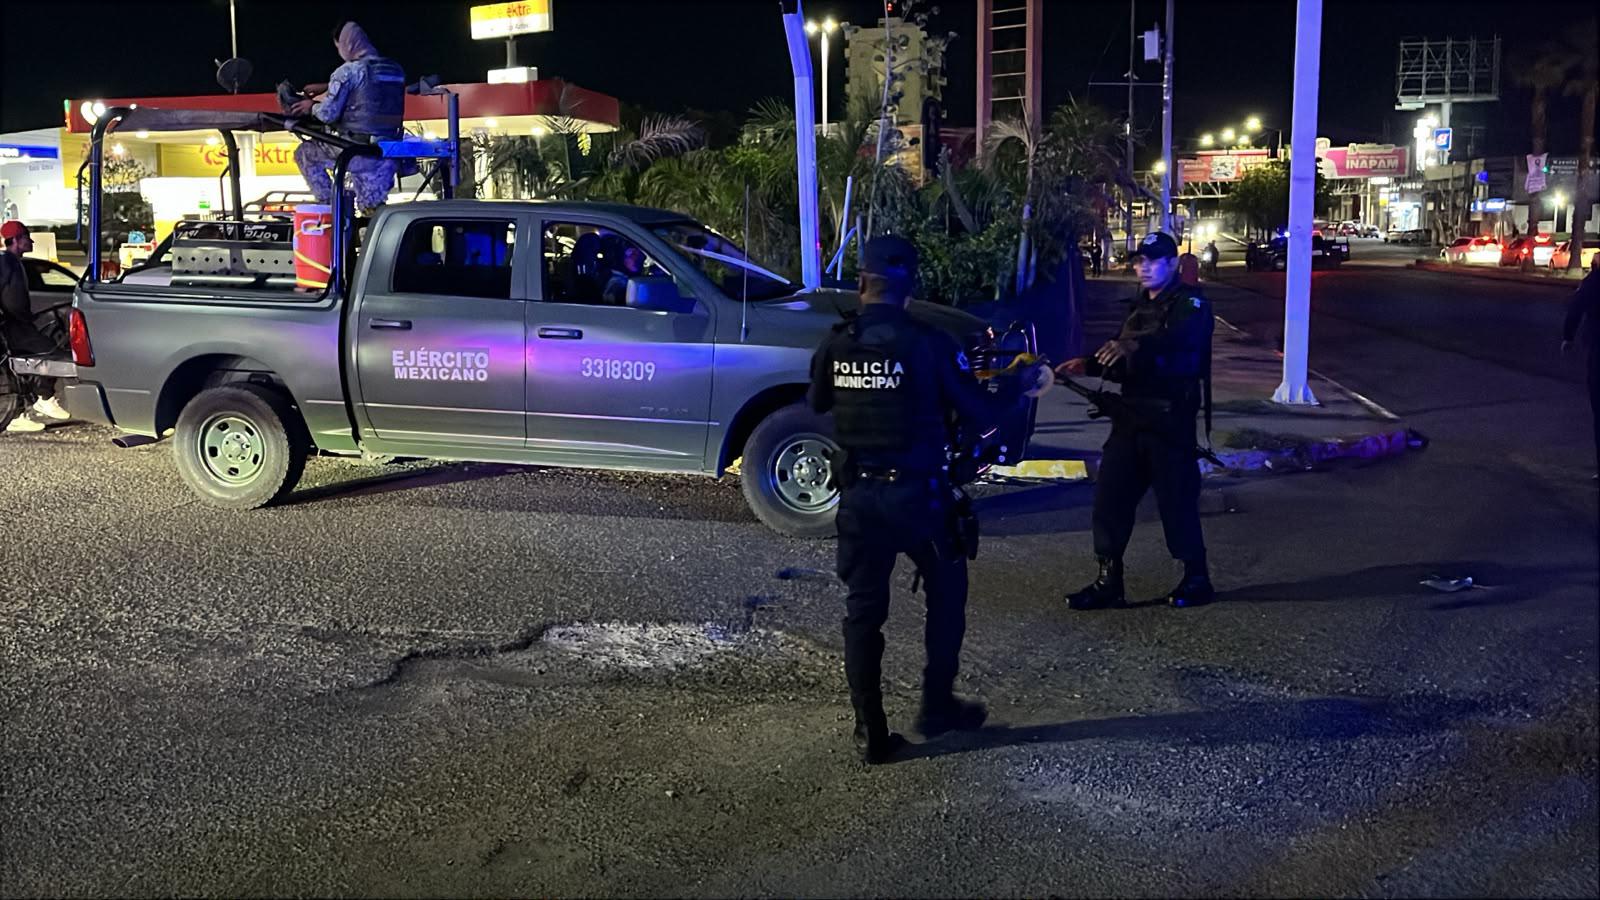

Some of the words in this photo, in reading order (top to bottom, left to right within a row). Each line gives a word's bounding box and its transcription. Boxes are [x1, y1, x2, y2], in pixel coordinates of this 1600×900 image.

[1345, 158, 1398, 169] INAPAM
[392, 347, 489, 368] EJÉRCITO
[394, 367, 488, 381] MEXICANO
[582, 358, 656, 381] 3318309
[834, 359, 904, 374] POLICÍA
